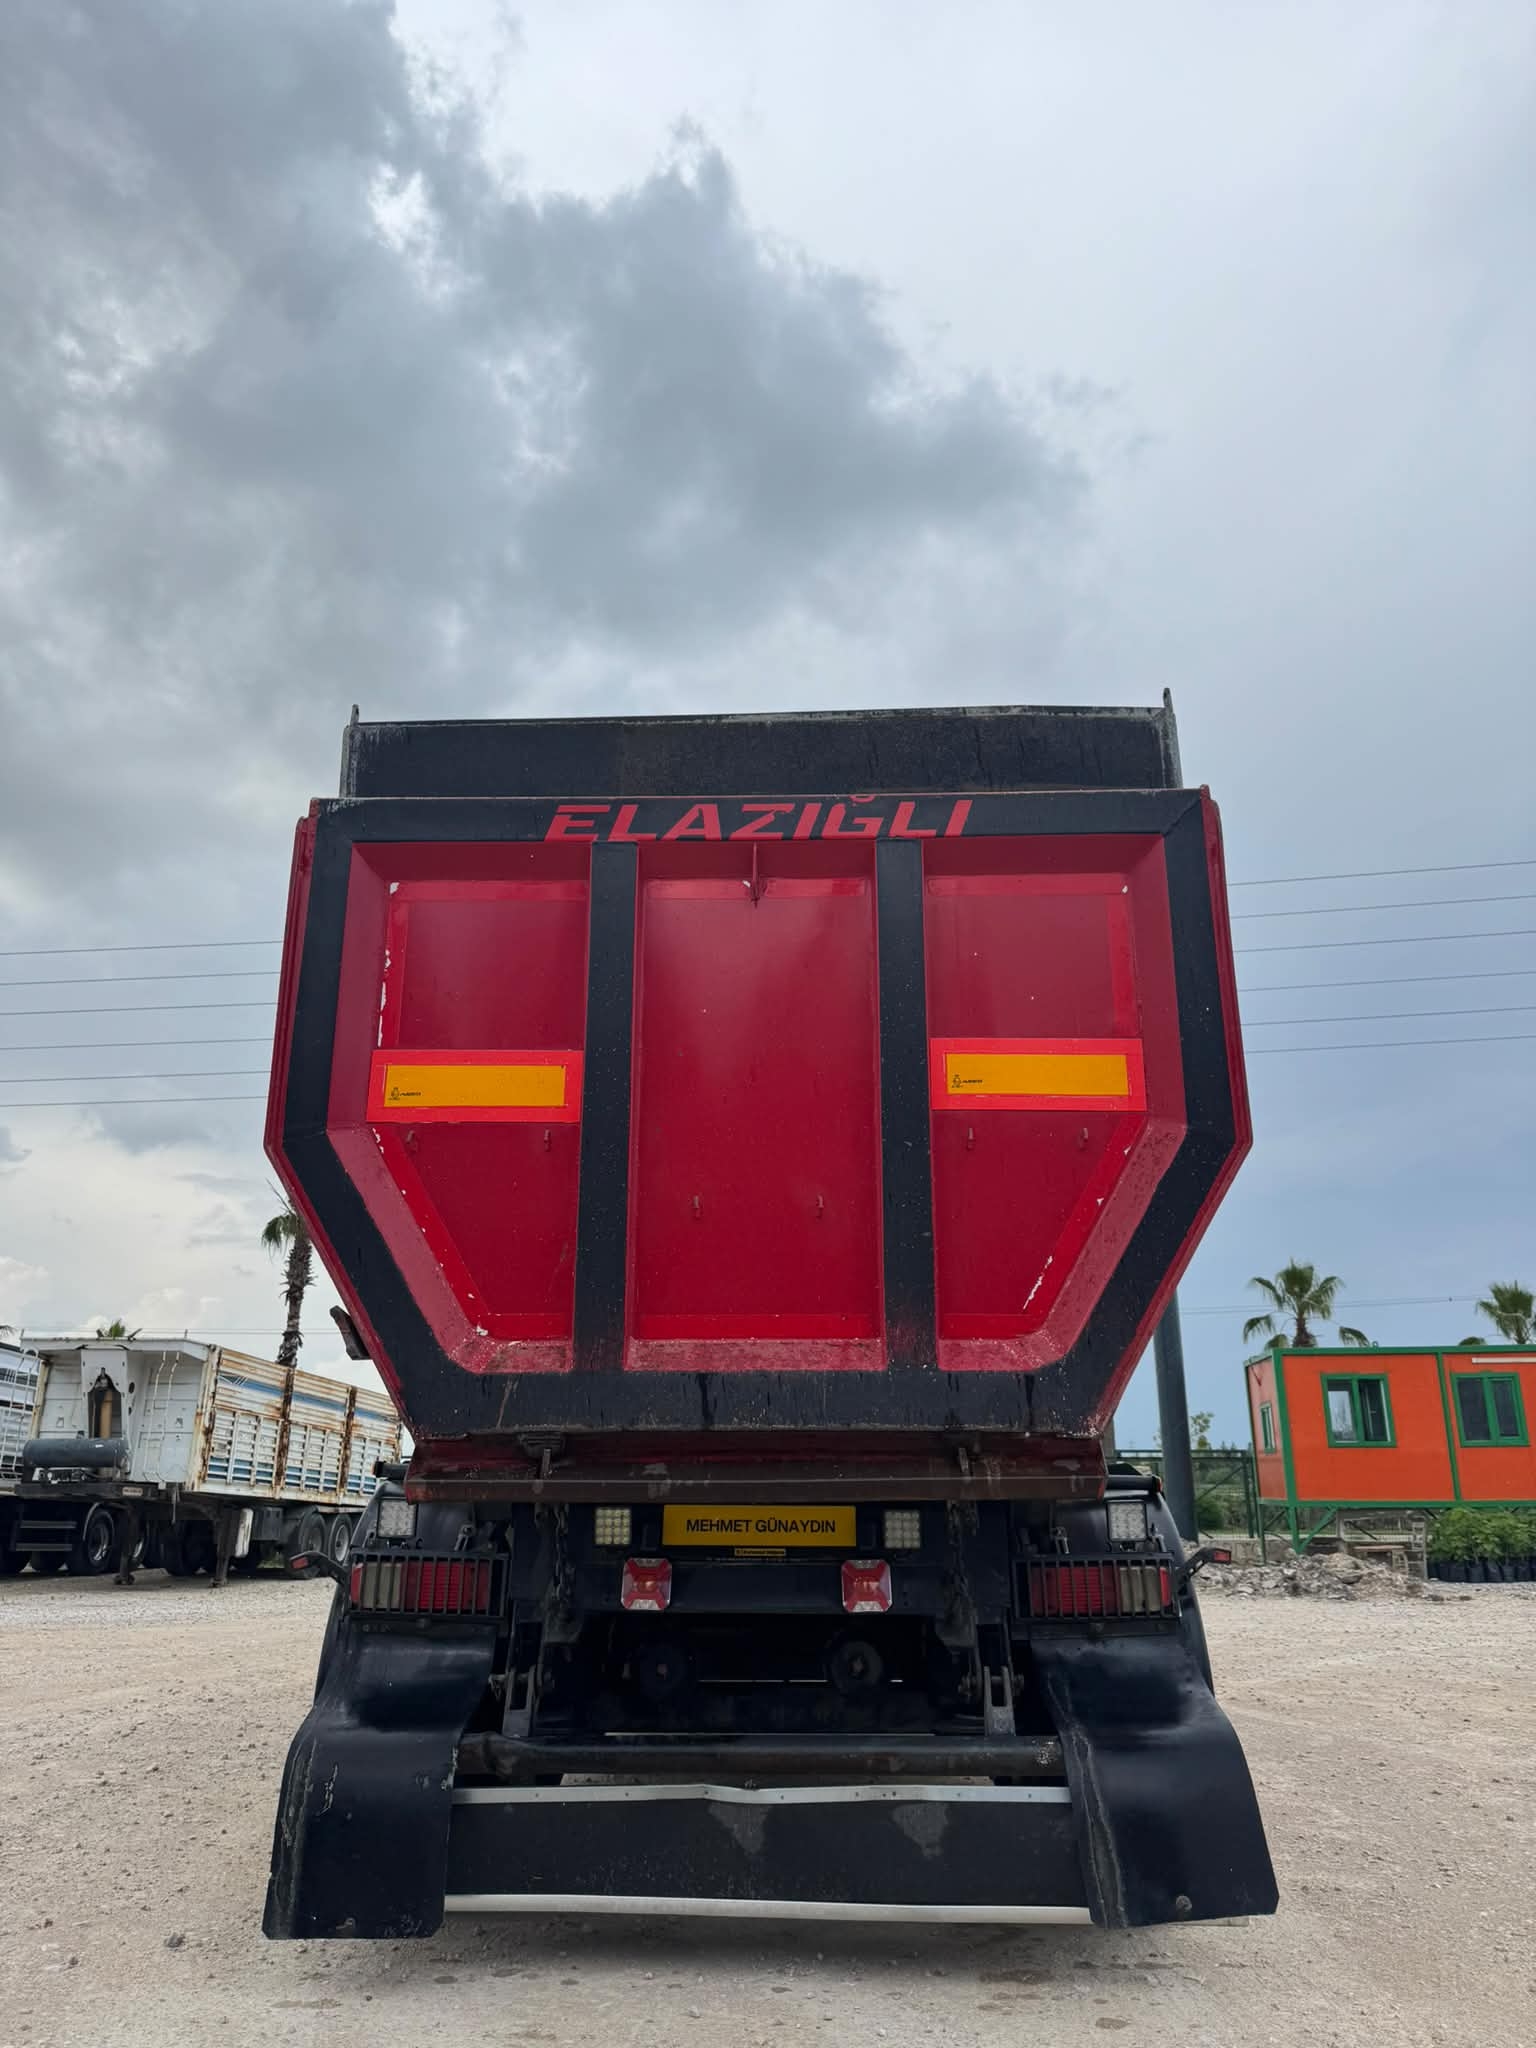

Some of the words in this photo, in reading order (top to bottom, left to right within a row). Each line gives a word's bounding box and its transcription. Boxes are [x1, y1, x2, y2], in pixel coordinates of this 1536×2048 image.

[544, 794, 973, 842] ELAZIĞLI
[686, 1519, 752, 1533] MEHMET
[754, 1517, 836, 1533] GÜNAYDIN
